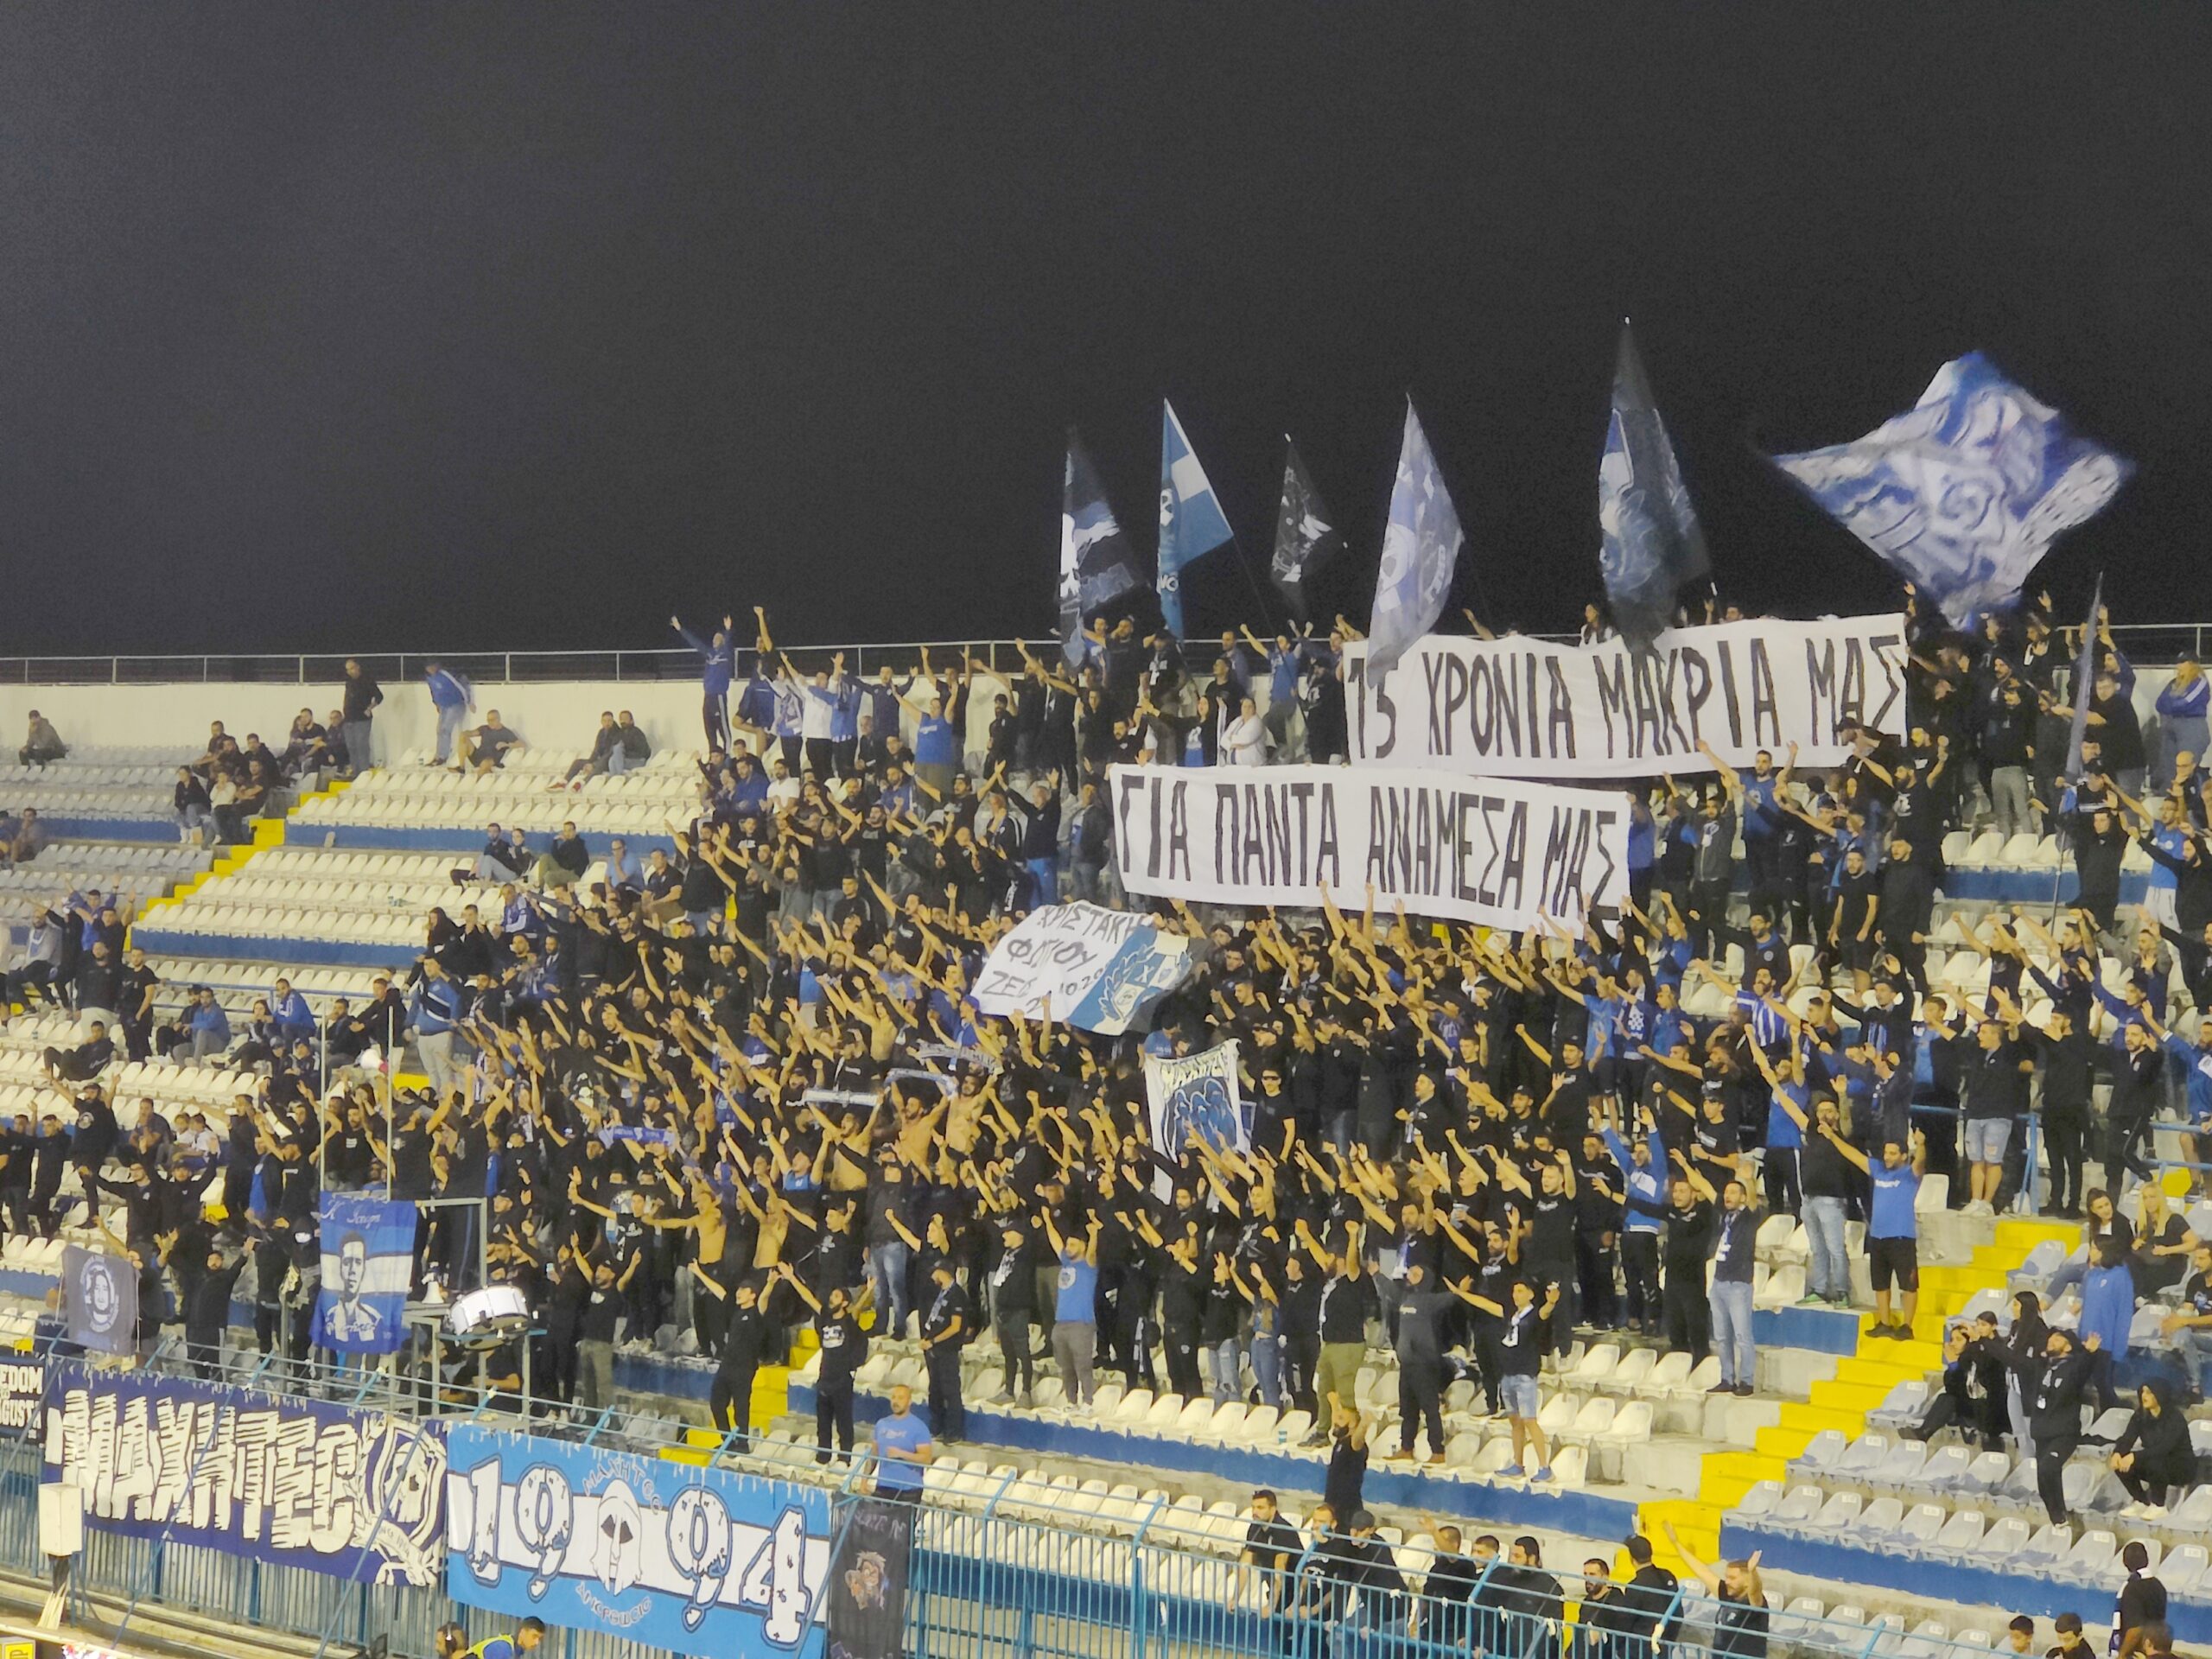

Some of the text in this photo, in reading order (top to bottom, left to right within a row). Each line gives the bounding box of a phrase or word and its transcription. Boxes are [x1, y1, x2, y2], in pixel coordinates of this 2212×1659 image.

[1348, 657, 1399, 760] 15
[1421, 652, 1577, 760] ΧΡΟΝΙΑ
[1592, 638, 1781, 760] ΜΑΚΡΙΑ
[1120, 773, 1620, 921] ΓΙΑ ΠΑΝΤΑ ΑΝΑΜΕΣΑ ΜΑΣ
